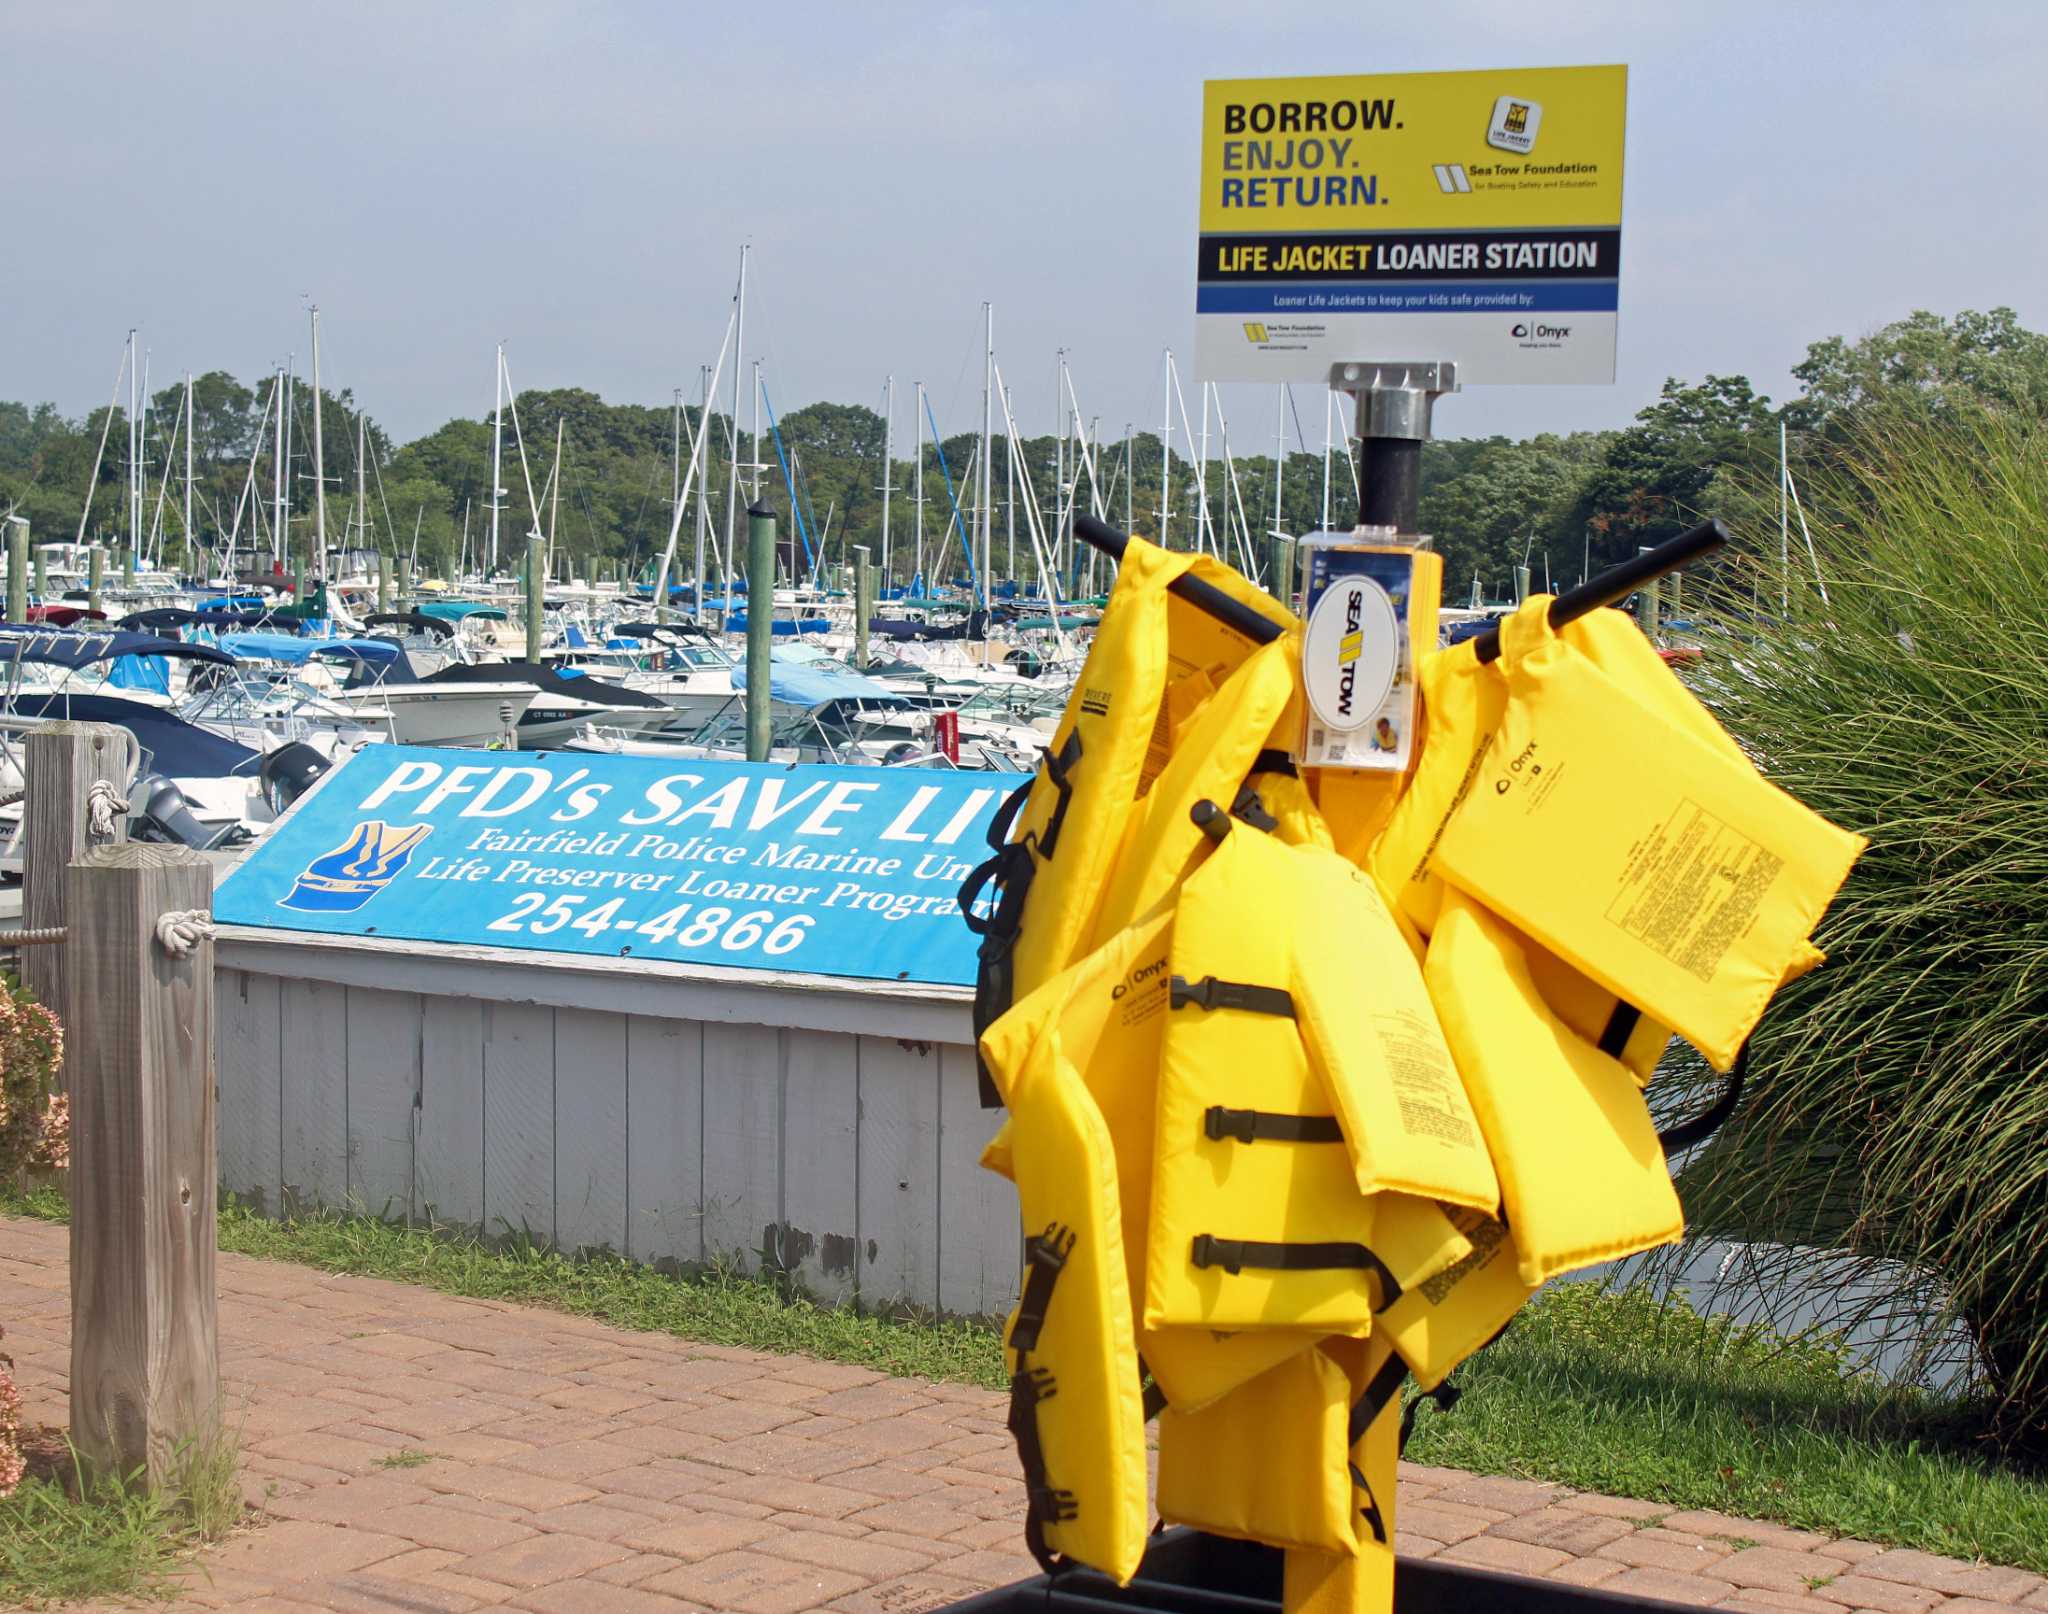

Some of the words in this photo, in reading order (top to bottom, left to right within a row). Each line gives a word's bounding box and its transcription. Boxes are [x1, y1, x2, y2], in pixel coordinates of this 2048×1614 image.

[1224, 99, 1404, 134] BORROW.
[1222, 138, 1359, 171] ENJOY.
[1469, 165, 1491, 177] Sea
[1494, 164, 1519, 176] Tow
[1524, 162, 1598, 175] Foundation
[1221, 175, 1389, 208] RETURN.
[1218, 246, 1268, 272] LIFE
[1272, 244, 1372, 271] JACKET
[1376, 243, 1479, 270] LOANER
[1485, 241, 1598, 269] STATION
[1273, 294, 1306, 306] Loaner
[1308, 294, 1326, 306] Life
[1327, 294, 1365, 306] Jackets
[1367, 295, 1377, 306] to
[1379, 294, 1402, 307] keep
[1404, 295, 1427, 306] your
[1429, 294, 1449, 305] kids
[1451, 294, 1472, 305] safe
[1474, 293, 1516, 306] provided
[1536, 325, 1569, 340] Onyx
[1345, 590, 1363, 634] SEA
[1338, 661, 1355, 716] TOW
[1510, 739, 1538, 772] Onyx
[358, 761, 613, 821] PFD's
[618, 774, 880, 836] SAVE
[466, 827, 630, 856] Fairfield
[626, 834, 747, 864] Police
[751, 842, 902, 876] Marine
[913, 854, 990, 881] Un
[415, 856, 491, 881] Life
[491, 859, 675, 892] Preserver
[675, 870, 820, 905] Loaner
[486, 892, 816, 955] 254-4866
[1134, 956, 1168, 983] Onyx
